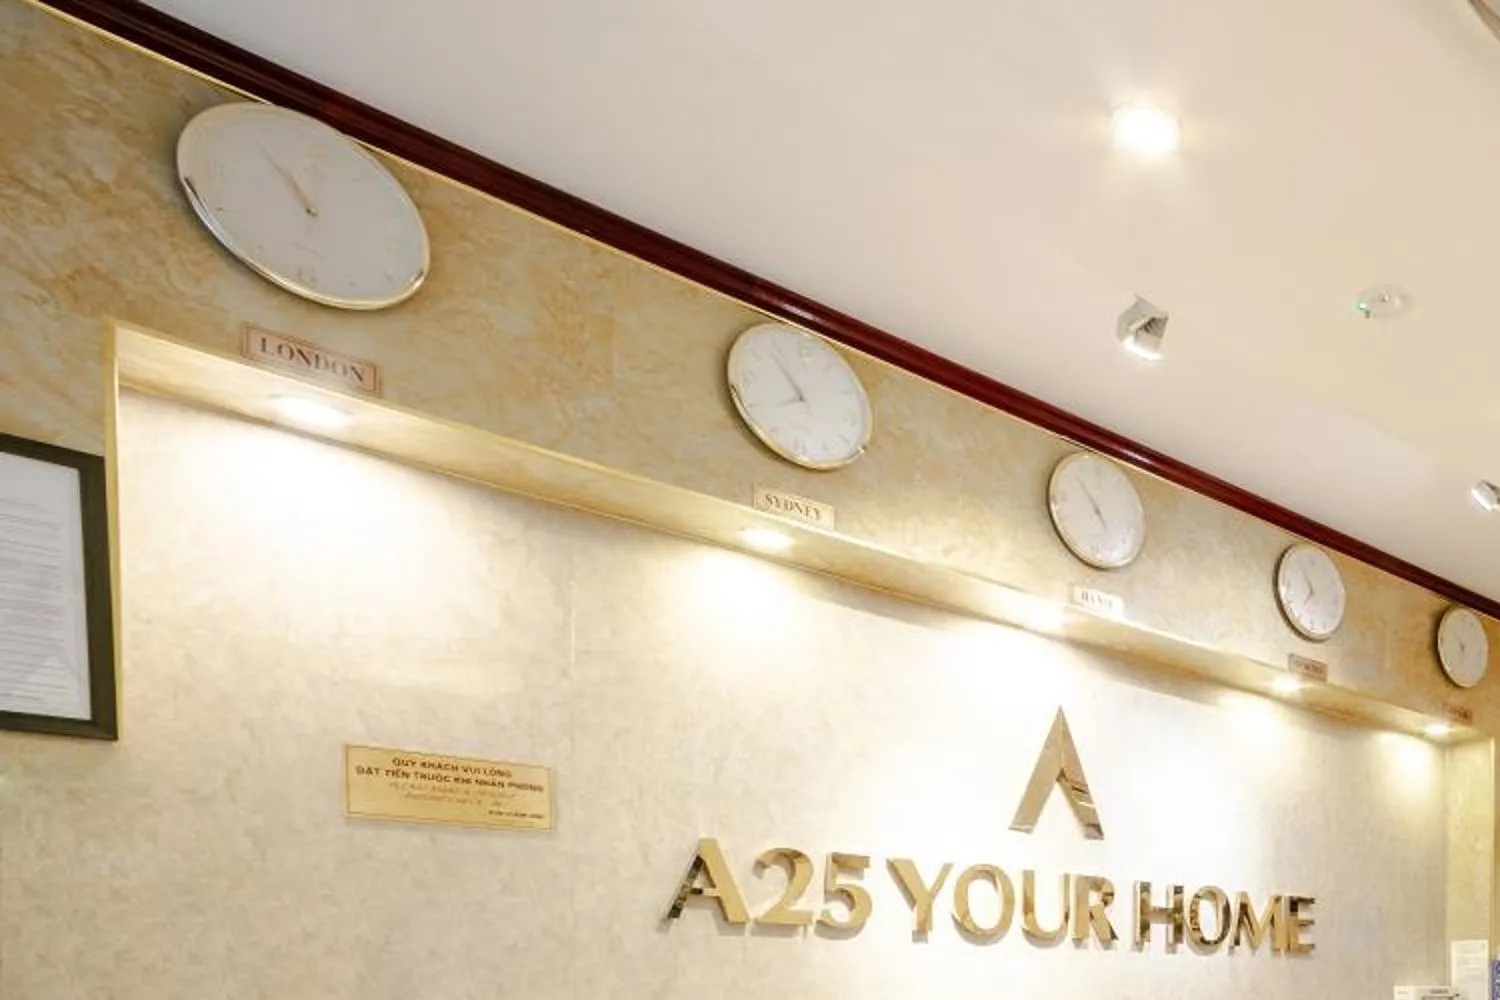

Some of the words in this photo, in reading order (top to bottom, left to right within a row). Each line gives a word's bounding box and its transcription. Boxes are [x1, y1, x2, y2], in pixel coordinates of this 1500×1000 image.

[259, 336, 364, 383] LONDON
[764, 493, 821, 521] SYDNEY
[886, 857, 1118, 942] YOUR
[1136, 879, 1316, 954] HOME
